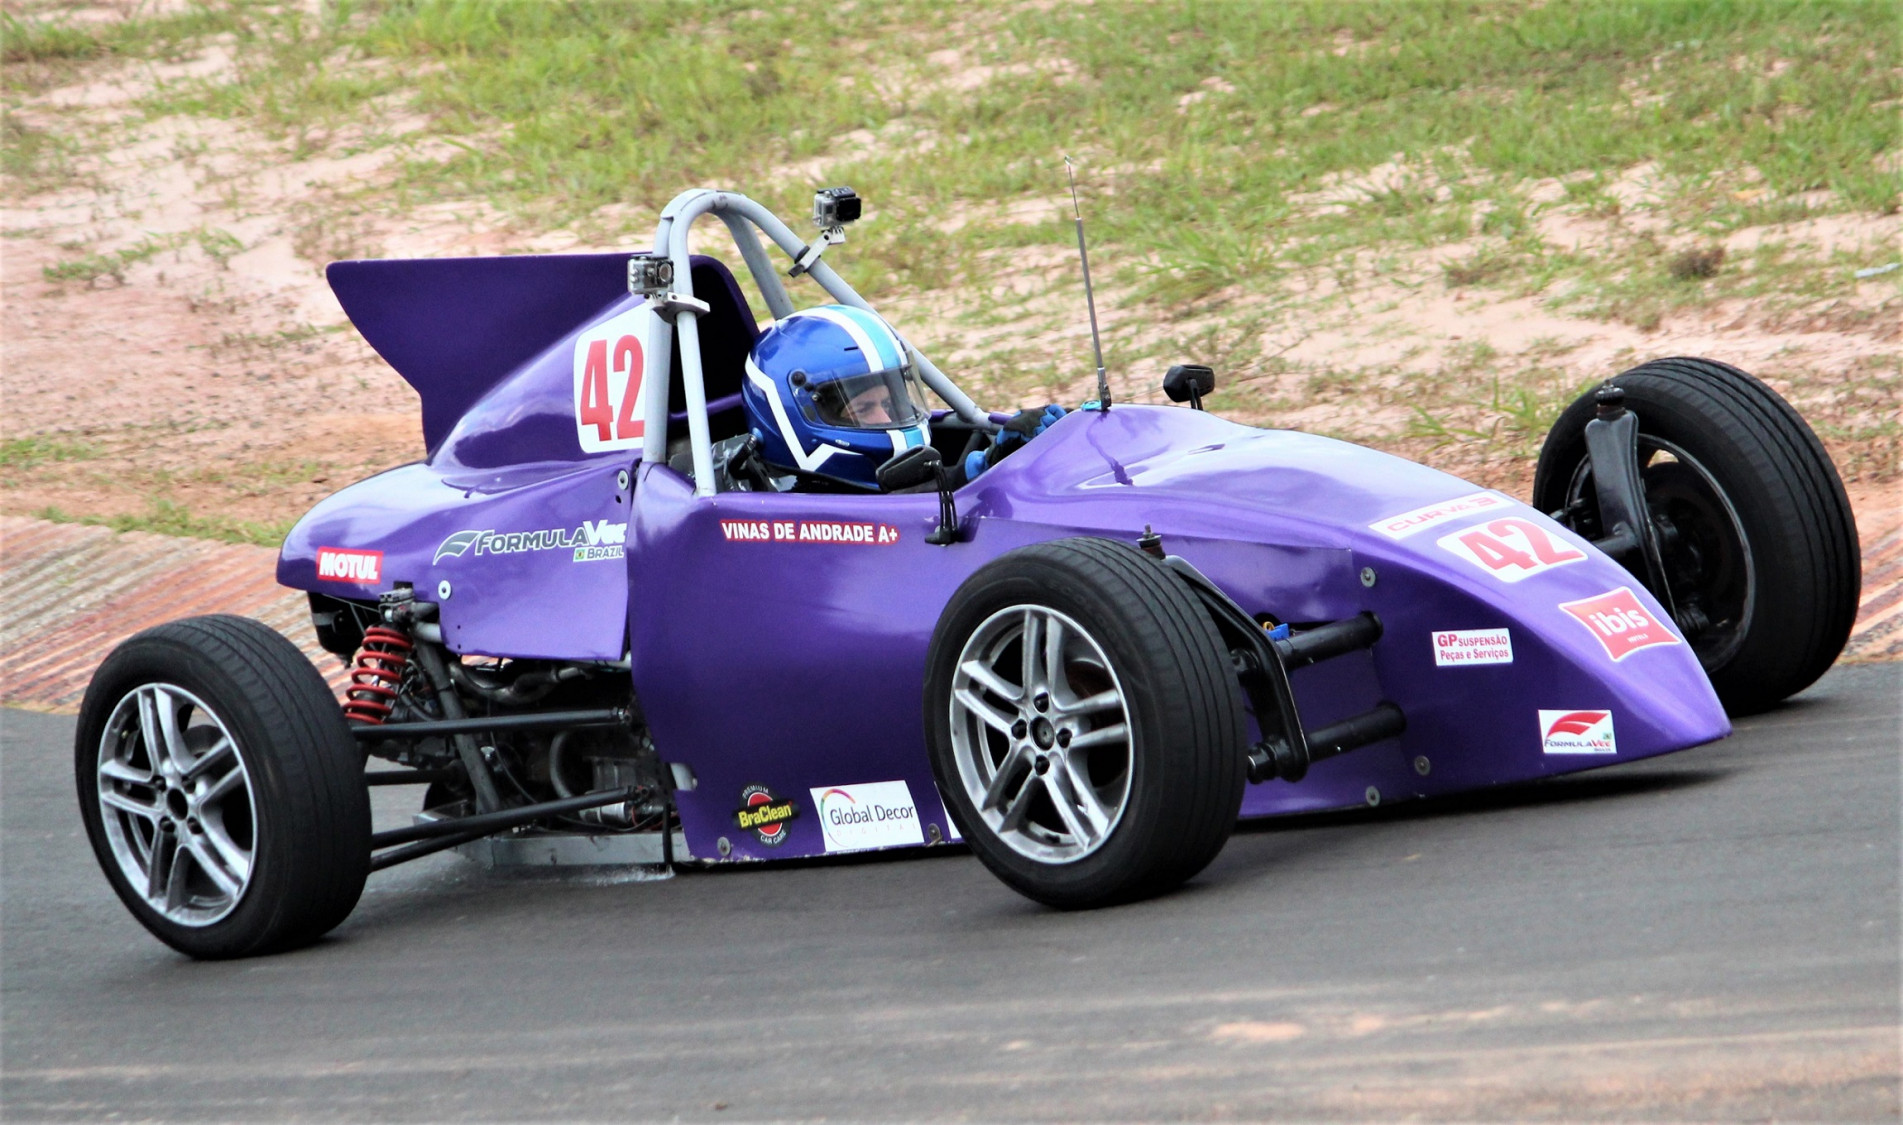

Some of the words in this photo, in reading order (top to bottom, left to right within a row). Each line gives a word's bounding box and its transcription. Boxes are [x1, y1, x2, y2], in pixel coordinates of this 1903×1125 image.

[580, 334, 645, 442] 42
[722, 522, 770, 540] VINAS
[774, 523, 795, 540] DE
[799, 523, 875, 542] ANDRADE
[878, 525, 898, 543] A+
[586, 547, 624, 560] BRAZIL
[1458, 519, 1585, 570] 42
[319, 551, 378, 580] MOTUL
[1588, 607, 1649, 636] ibis
[1437, 633, 1458, 647] GP
[1458, 634, 1508, 647] SUSPENSÃO
[1440, 650, 1465, 662] Peças
[1466, 651, 1472, 659] e
[1473, 647, 1509, 660] Serviços
[742, 785, 769, 799] PREMIUM
[738, 804, 792, 828] BraClean
[830, 805, 874, 826] Global
[874, 804, 914, 822] Decor
[760, 834, 773, 845] CAR
[773, 829, 786, 845] CARE
